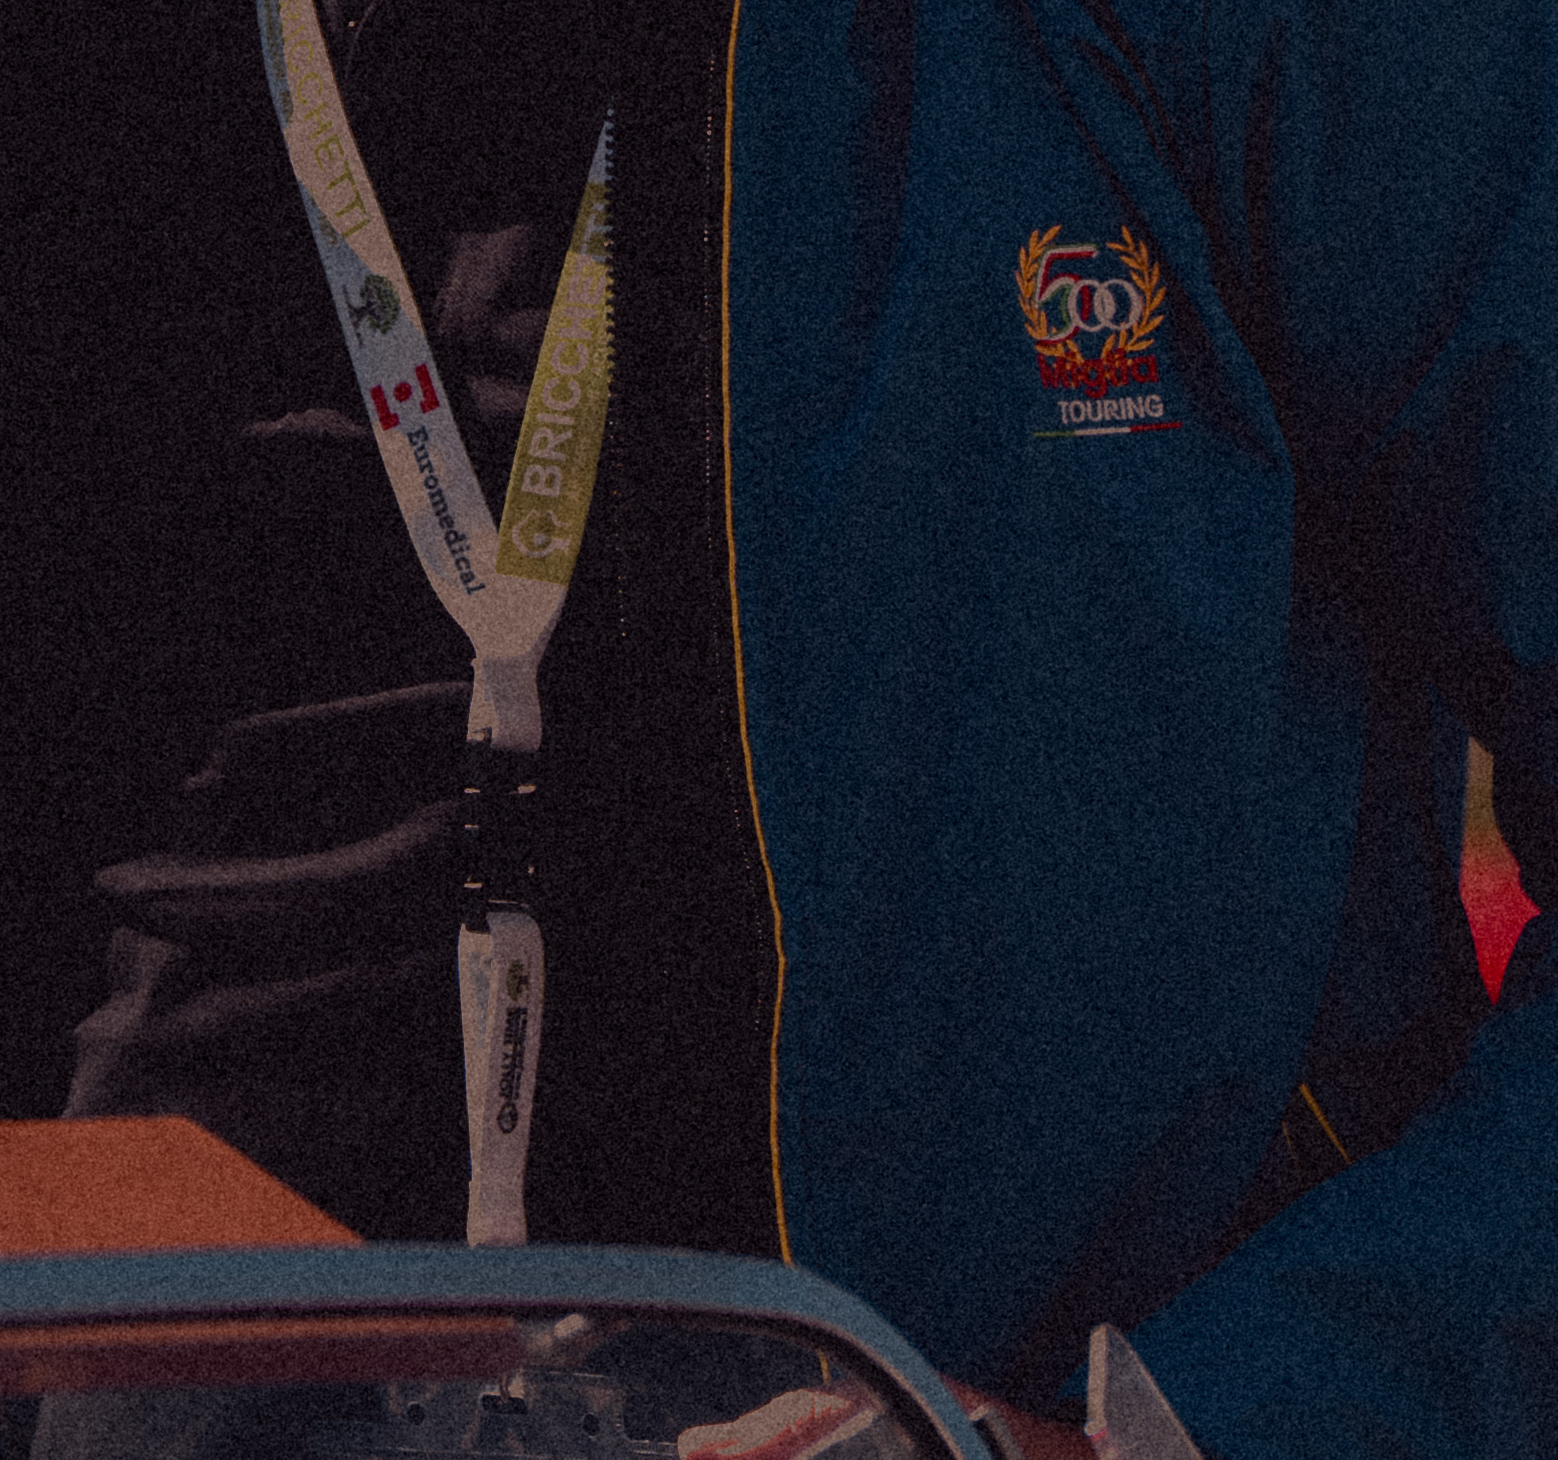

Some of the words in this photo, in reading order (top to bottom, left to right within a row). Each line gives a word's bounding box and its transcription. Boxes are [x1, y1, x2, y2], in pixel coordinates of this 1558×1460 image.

[1035, 242, 1142, 344] 500
[1057, 393, 1164, 425] TOURING
[407, 425, 487, 596] Euromedical
